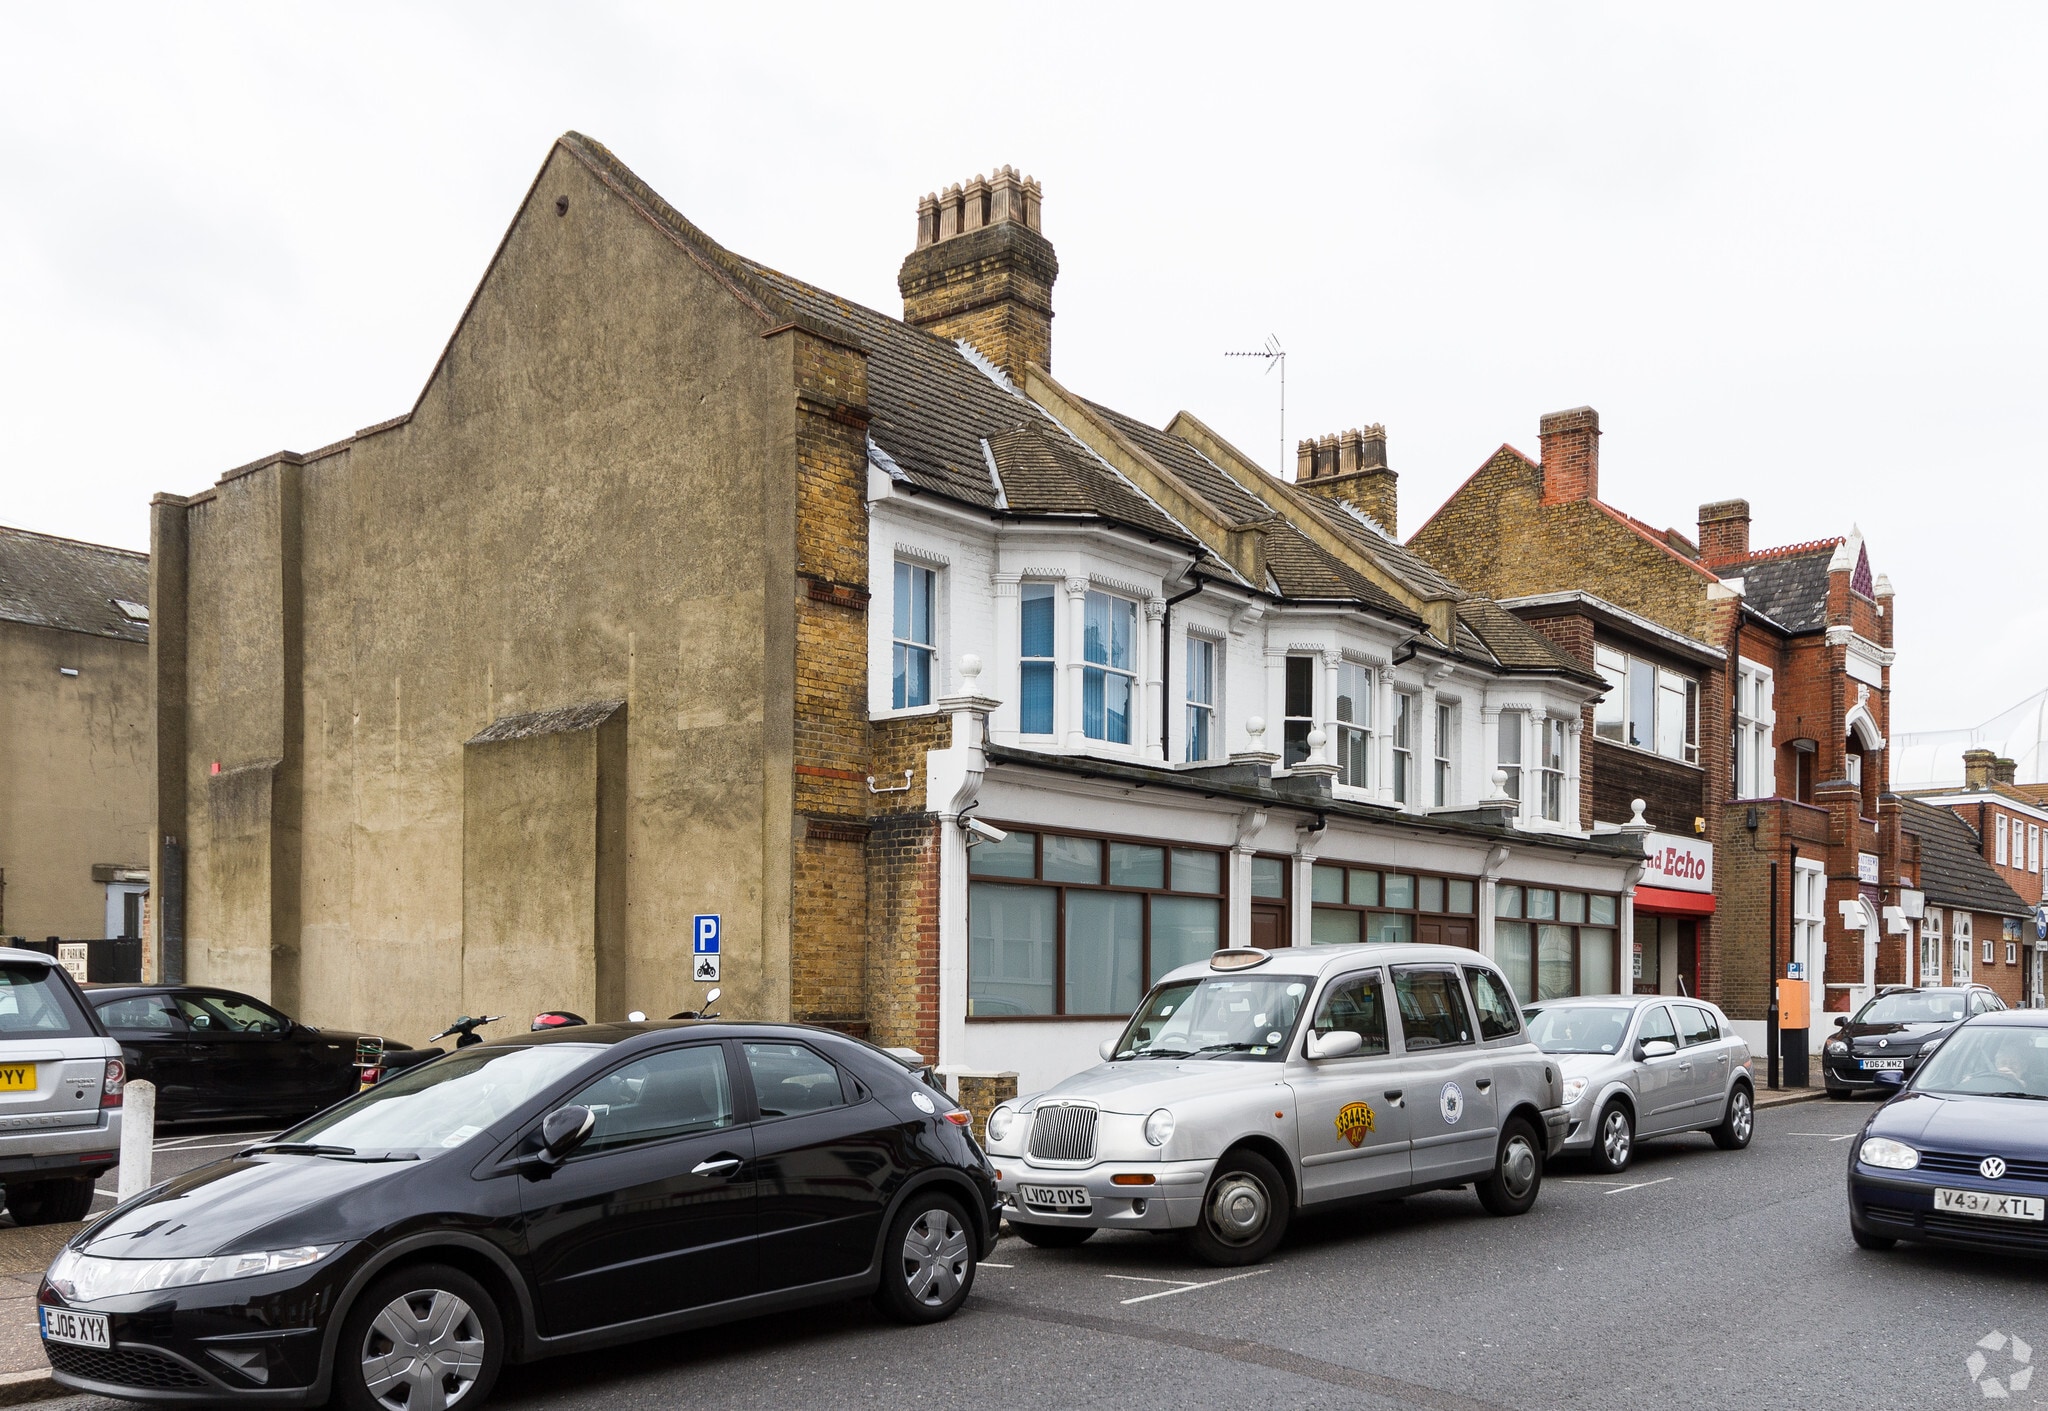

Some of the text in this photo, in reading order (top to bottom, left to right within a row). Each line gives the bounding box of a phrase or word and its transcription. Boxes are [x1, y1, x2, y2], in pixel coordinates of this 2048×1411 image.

[1663, 847, 1705, 880] Echo
[700, 919, 716, 950] P
[61, 948, 85, 959] NO PARKING
[1339, 1108, 1372, 1133] 334455
[1351, 1127, 1362, 1142] AC
[1025, 1187, 1085, 1205] LV02 OYS
[1943, 1191, 2035, 1217] V437 XTL
[46, 1311, 106, 1343] EJ06 XYX
